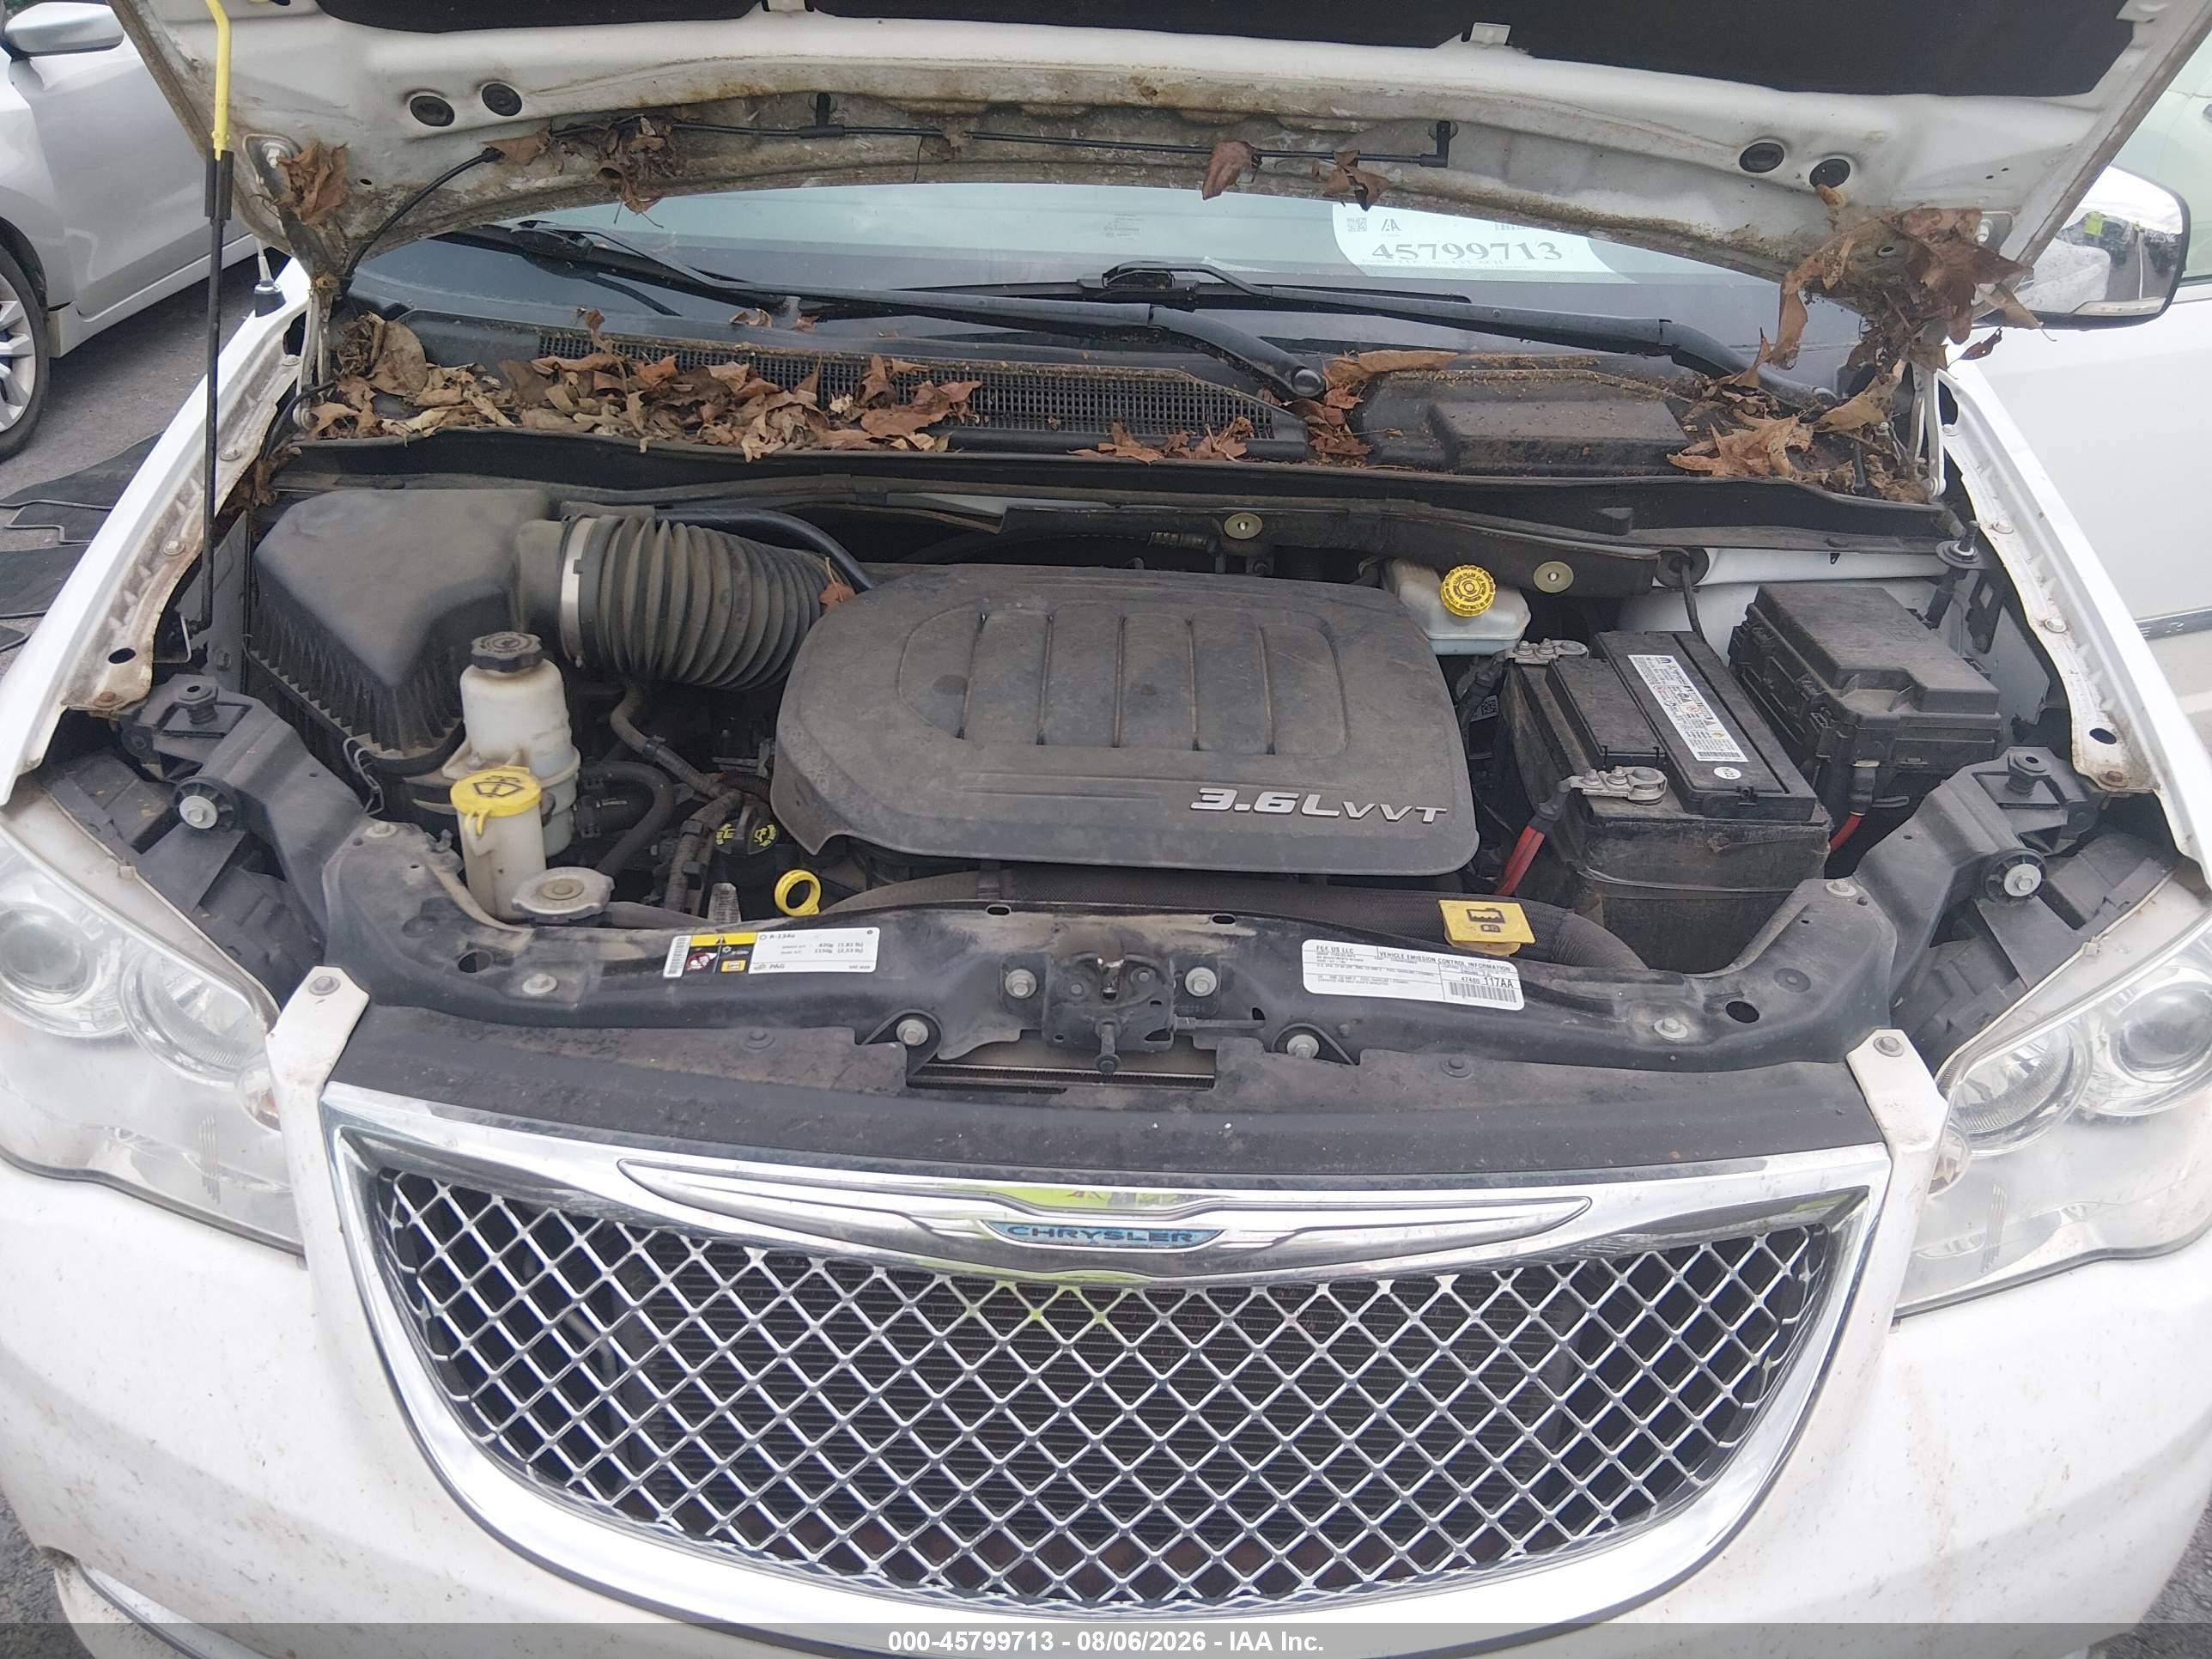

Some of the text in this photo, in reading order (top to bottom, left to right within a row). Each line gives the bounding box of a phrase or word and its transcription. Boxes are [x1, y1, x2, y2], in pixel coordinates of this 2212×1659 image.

[1371, 240, 1563, 260] 45799713
[1379, 951, 1404, 959] VEHICLE
[1407, 954, 1437, 963] EMISSION
[1437, 957, 1466, 967] CONTROL
[1468, 961, 1510, 972] INFORMATION
[1484, 975, 1514, 988] 117AA
[1007, 1226, 1193, 1243] CHRYSLER
